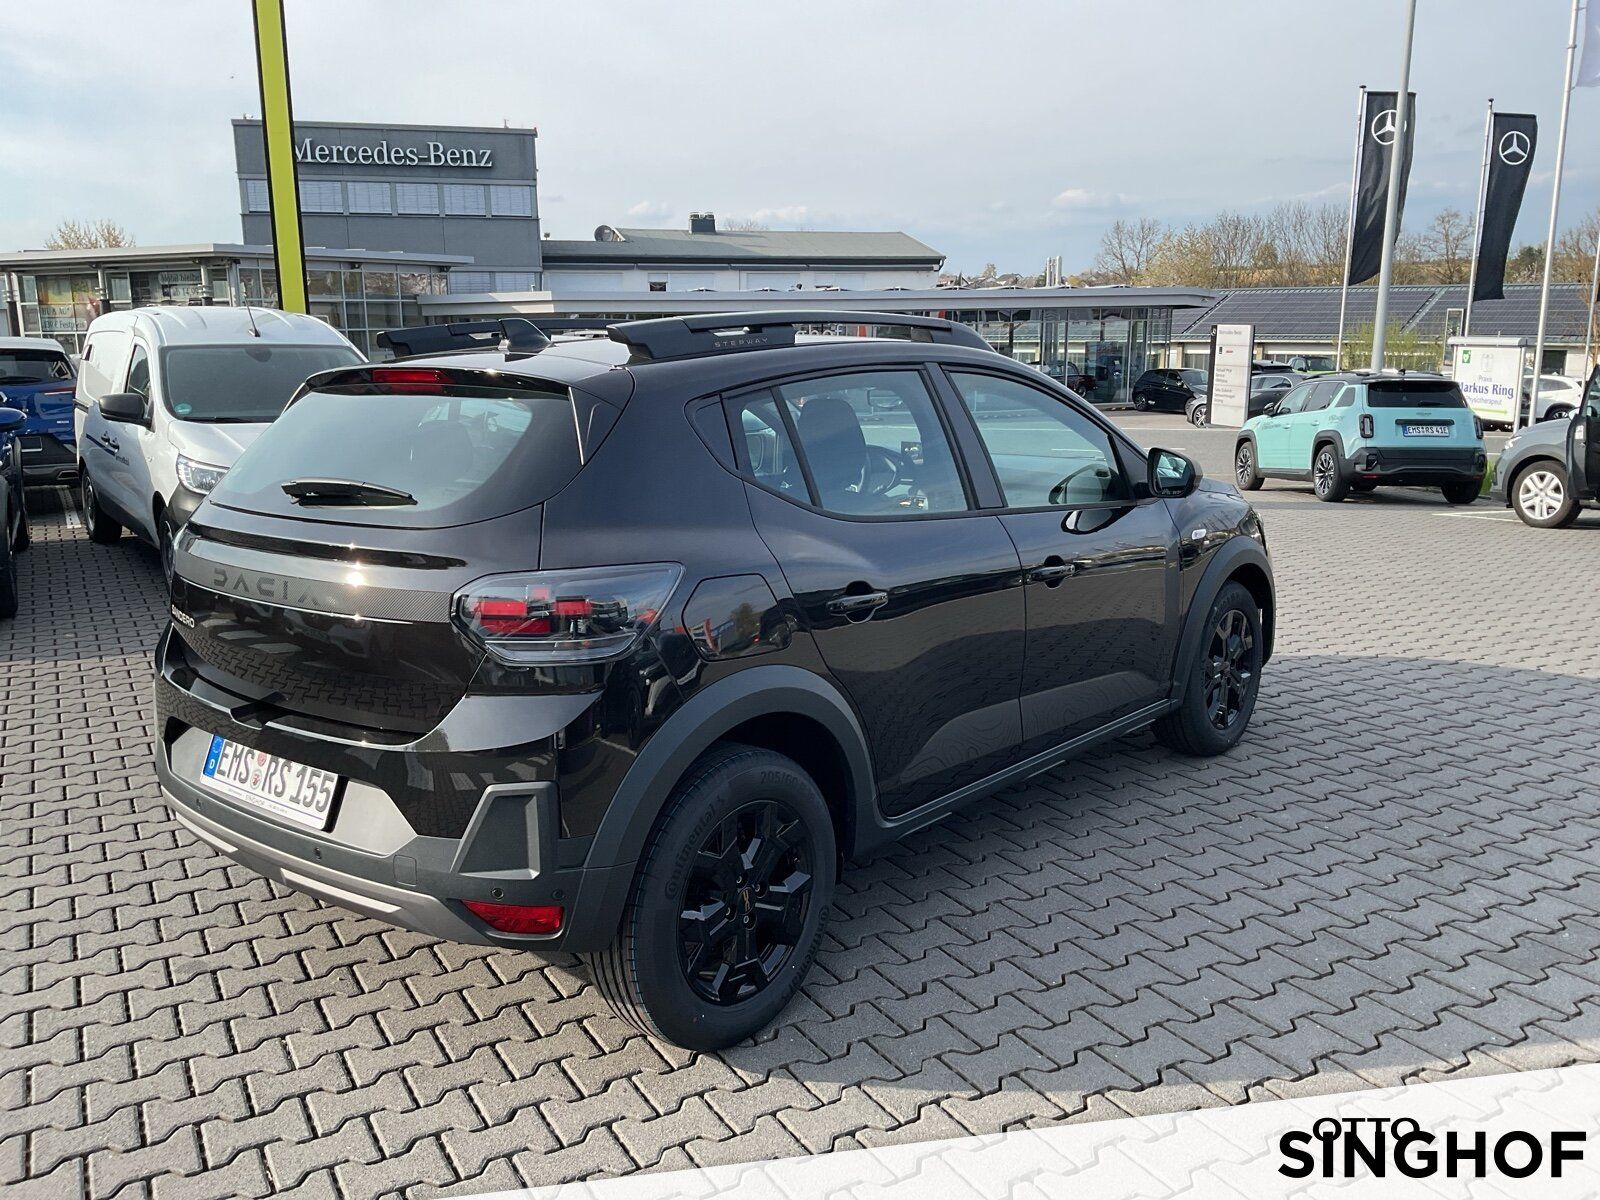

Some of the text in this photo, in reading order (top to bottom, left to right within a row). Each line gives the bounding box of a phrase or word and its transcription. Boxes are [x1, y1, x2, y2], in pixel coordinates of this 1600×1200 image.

[714, 337, 768, 348] STEPWAY
[1491, 383, 1514, 399] Ring
[1407, 426, 1421, 434] EMS
[213, 567, 321, 607] DACIA
[216, 741, 255, 784] EMS
[262, 754, 293, 798] RS
[289, 765, 335, 813] 155
